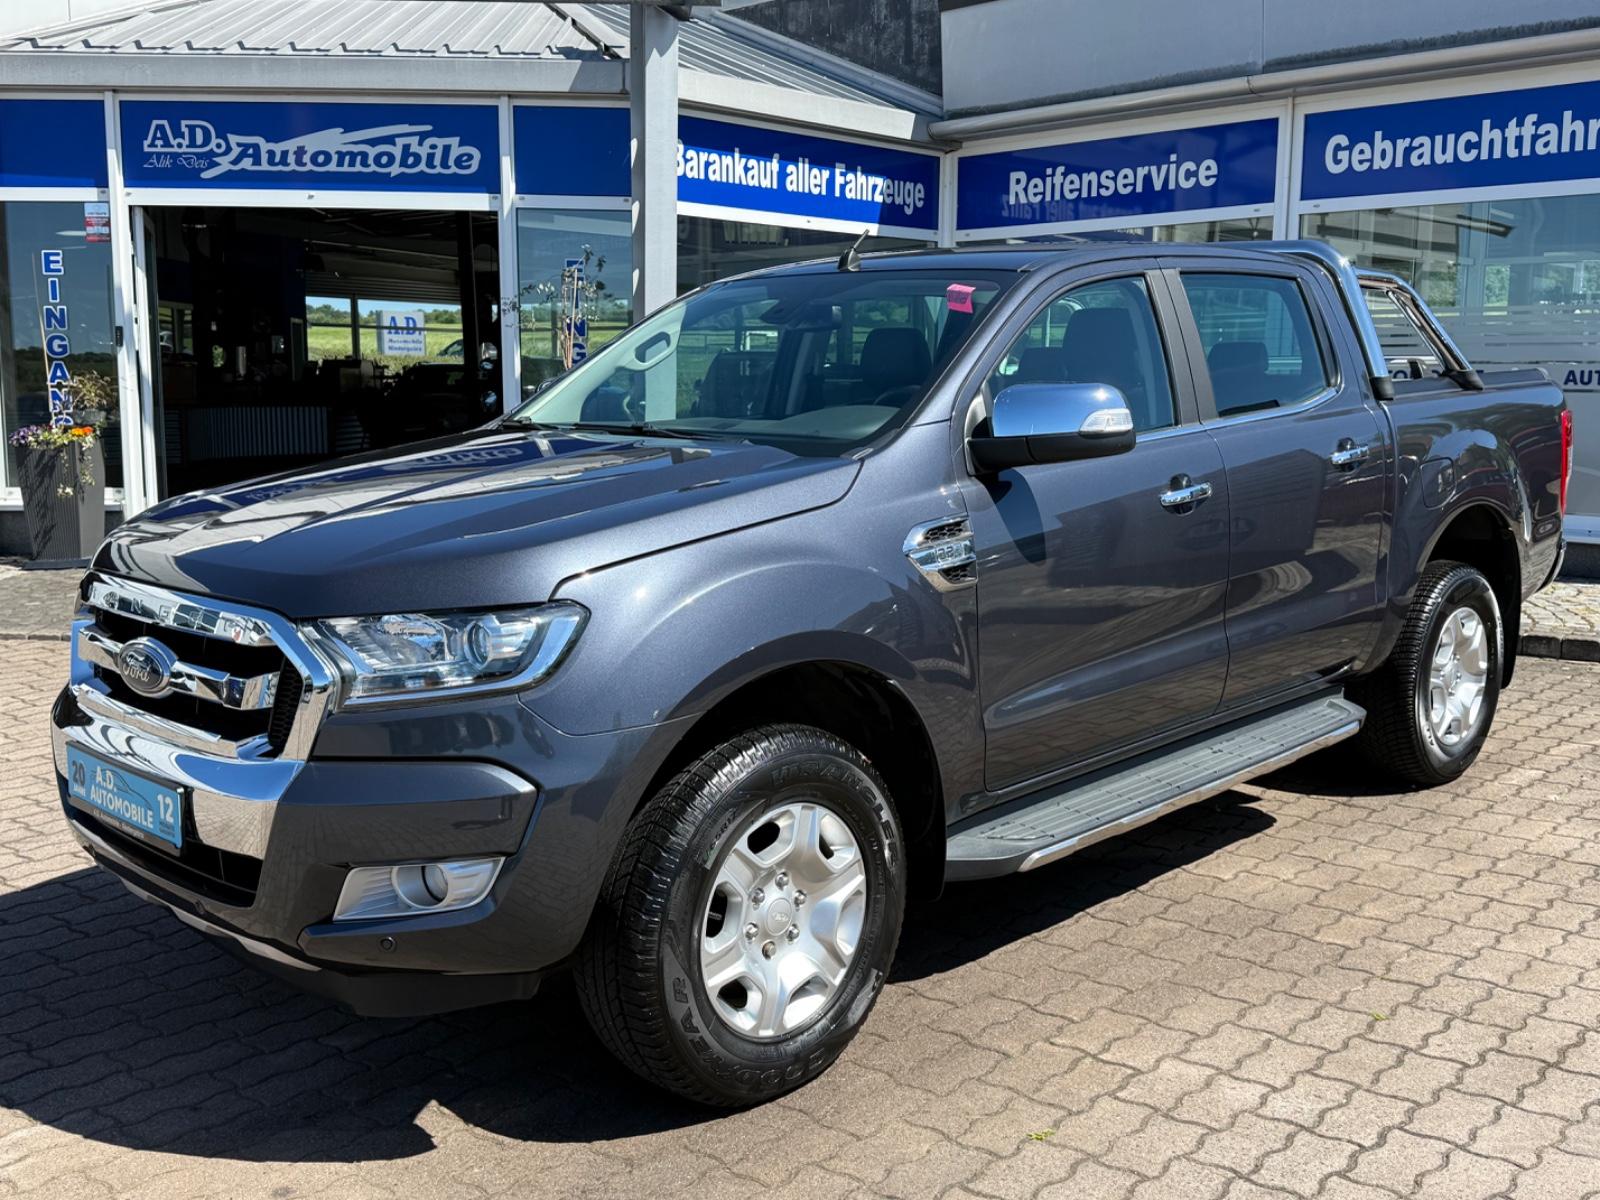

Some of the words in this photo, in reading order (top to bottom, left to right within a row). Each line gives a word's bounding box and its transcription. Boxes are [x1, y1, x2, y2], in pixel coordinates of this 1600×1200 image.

[143, 119, 226, 153] A.D.
[1325, 109, 1600, 175] Gebrauchtfahr
[230, 136, 481, 176] Automobile
[785, 157, 829, 196] aller
[834, 163, 925, 215] Fahrzeuge
[1009, 153, 1219, 205] Reifenservice
[122, 651, 152, 682] Ford
[72, 760, 86, 787] 20
[95, 765, 117, 793] A.D.
[90, 784, 154, 829] AUTOMOBILE
[157, 793, 175, 823] 12
